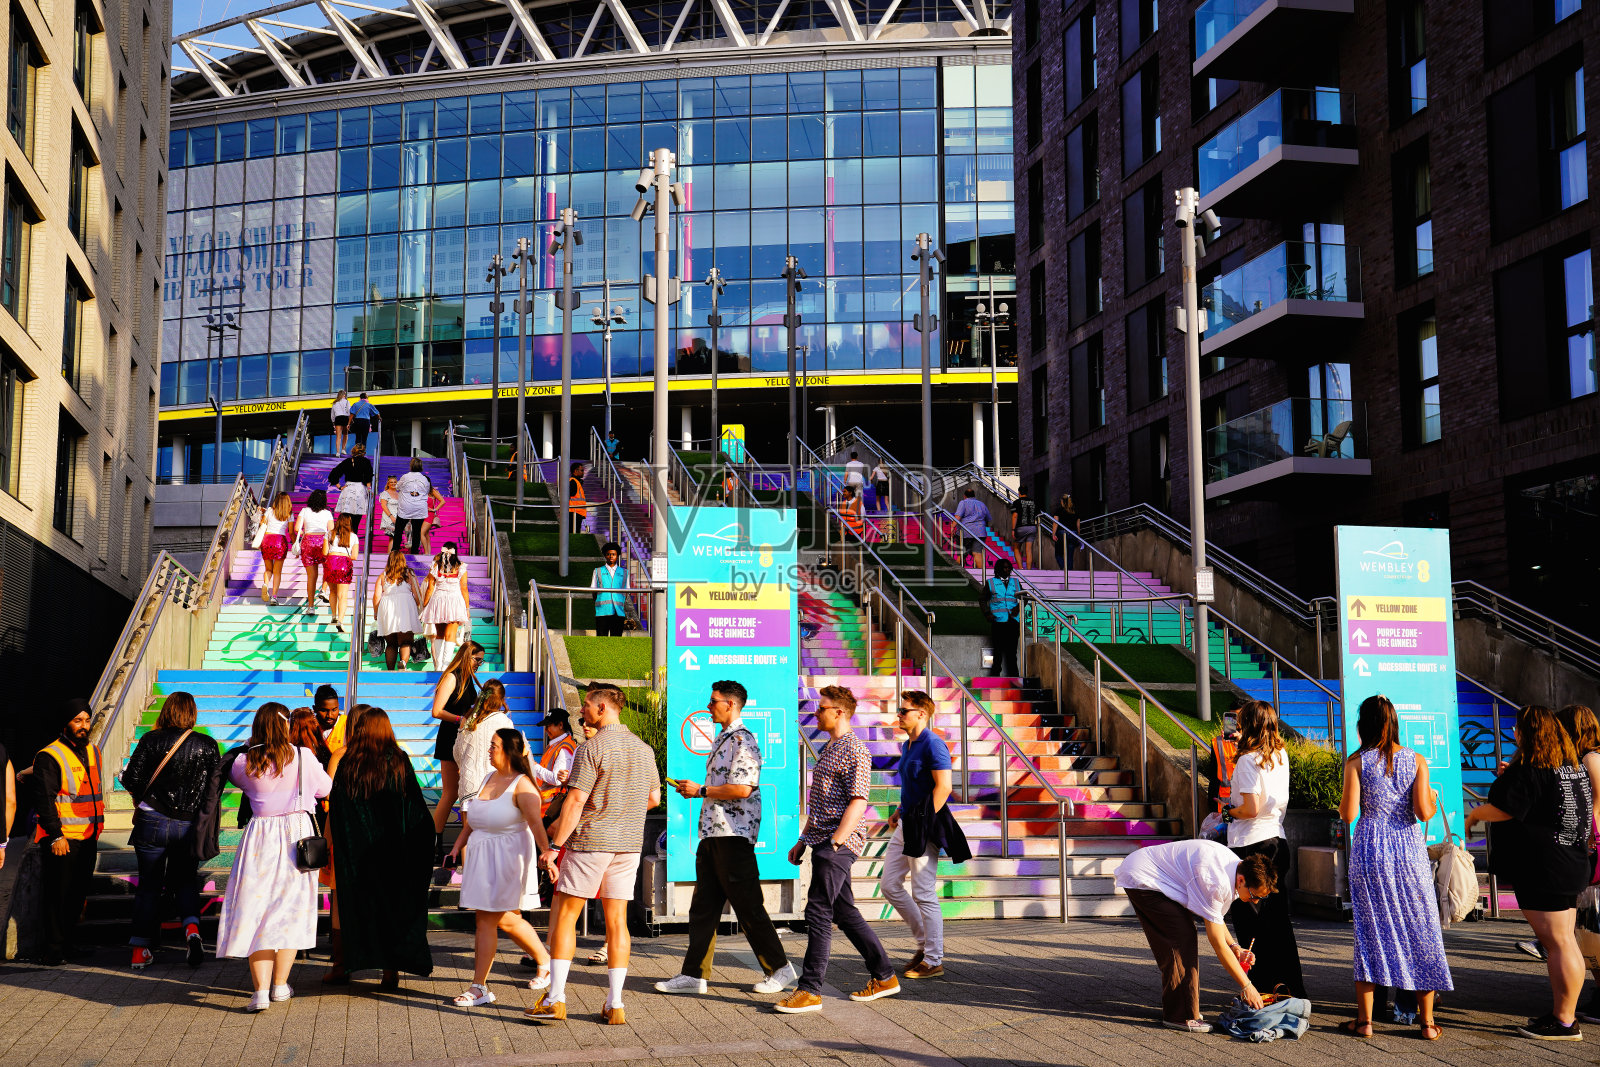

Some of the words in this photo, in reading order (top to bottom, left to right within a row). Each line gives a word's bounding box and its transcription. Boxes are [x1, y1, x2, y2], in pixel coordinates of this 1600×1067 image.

[237, 222, 316, 271] SWIFT
[252, 267, 313, 292] TOUR
[532, 386, 556, 394] ZONE
[234, 403, 265, 413] YELLOW
[266, 402, 287, 411] ZONE
[692, 546, 756, 556] WEMBLEY
[1360, 561, 1414, 573] WEMBLEY
[708, 591, 738, 600] YELLOW
[738, 592, 758, 601] ZONE
[1376, 604, 1400, 612] YELLOW
[1402, 604, 1418, 614] ZONE
[708, 617, 736, 627] PURPLE
[737, 618, 756, 628] ZONE
[708, 628, 724, 638] USE
[724, 628, 755, 638] GINNELS
[1376, 628, 1400, 637] PURPLE
[1401, 628, 1418, 638] ZONE
[1377, 638, 1390, 647] USE
[708, 654, 752, 664] ACCESSIBLE
[754, 654, 778, 664] ROUTE
[1378, 662, 1416, 672] ACCESSIBLE
[1417, 662, 1438, 672] ROUTE
